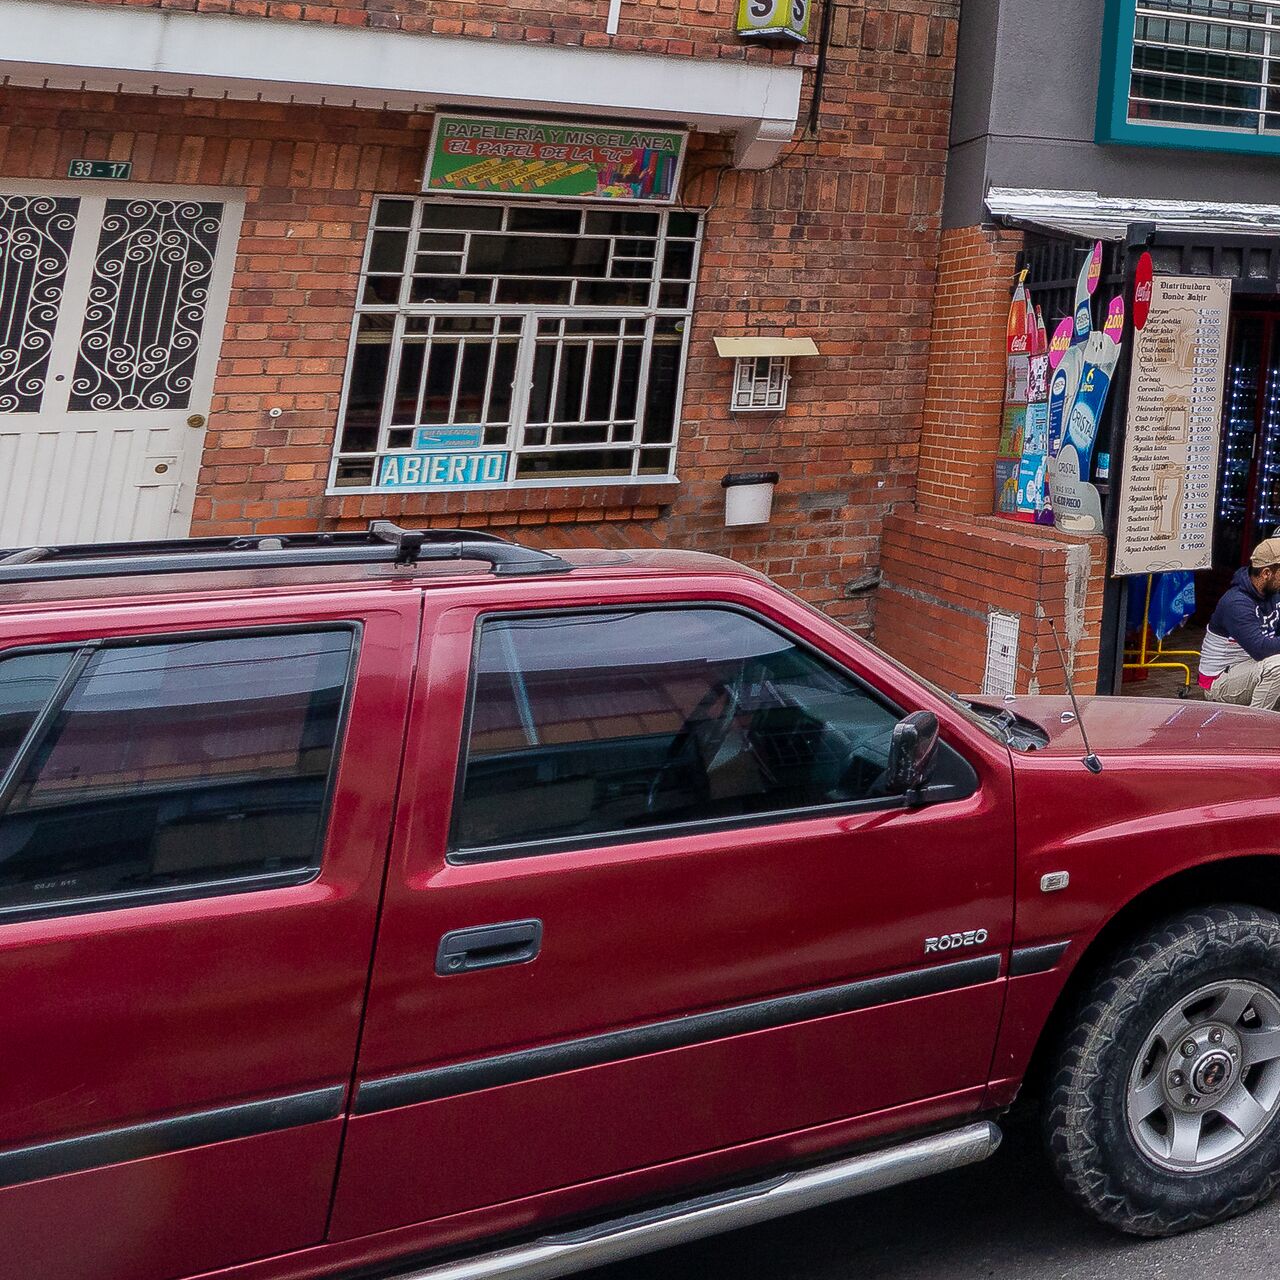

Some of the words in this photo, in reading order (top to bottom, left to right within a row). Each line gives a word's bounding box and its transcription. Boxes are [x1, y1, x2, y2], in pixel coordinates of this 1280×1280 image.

[445, 123, 545, 142] PAPELERÍA
[551, 131, 560, 143] Y
[565, 131, 674, 151] MISCELÁNEA
[449, 140, 473, 154] EL
[476, 142, 535, 157] PAPEL
[540, 146, 567, 159] DE
[570, 148, 594, 160] LA
[74, 162, 93, 176] 33
[110, 164, 127, 178] 17
[1160, 281, 1211, 291] Distribuidora
[1162, 292, 1185, 301] Donde
[1072, 408, 1095, 440] CRISTAL
[382, 455, 502, 484] ABIERTO
[924, 928, 988, 955] RODEO
